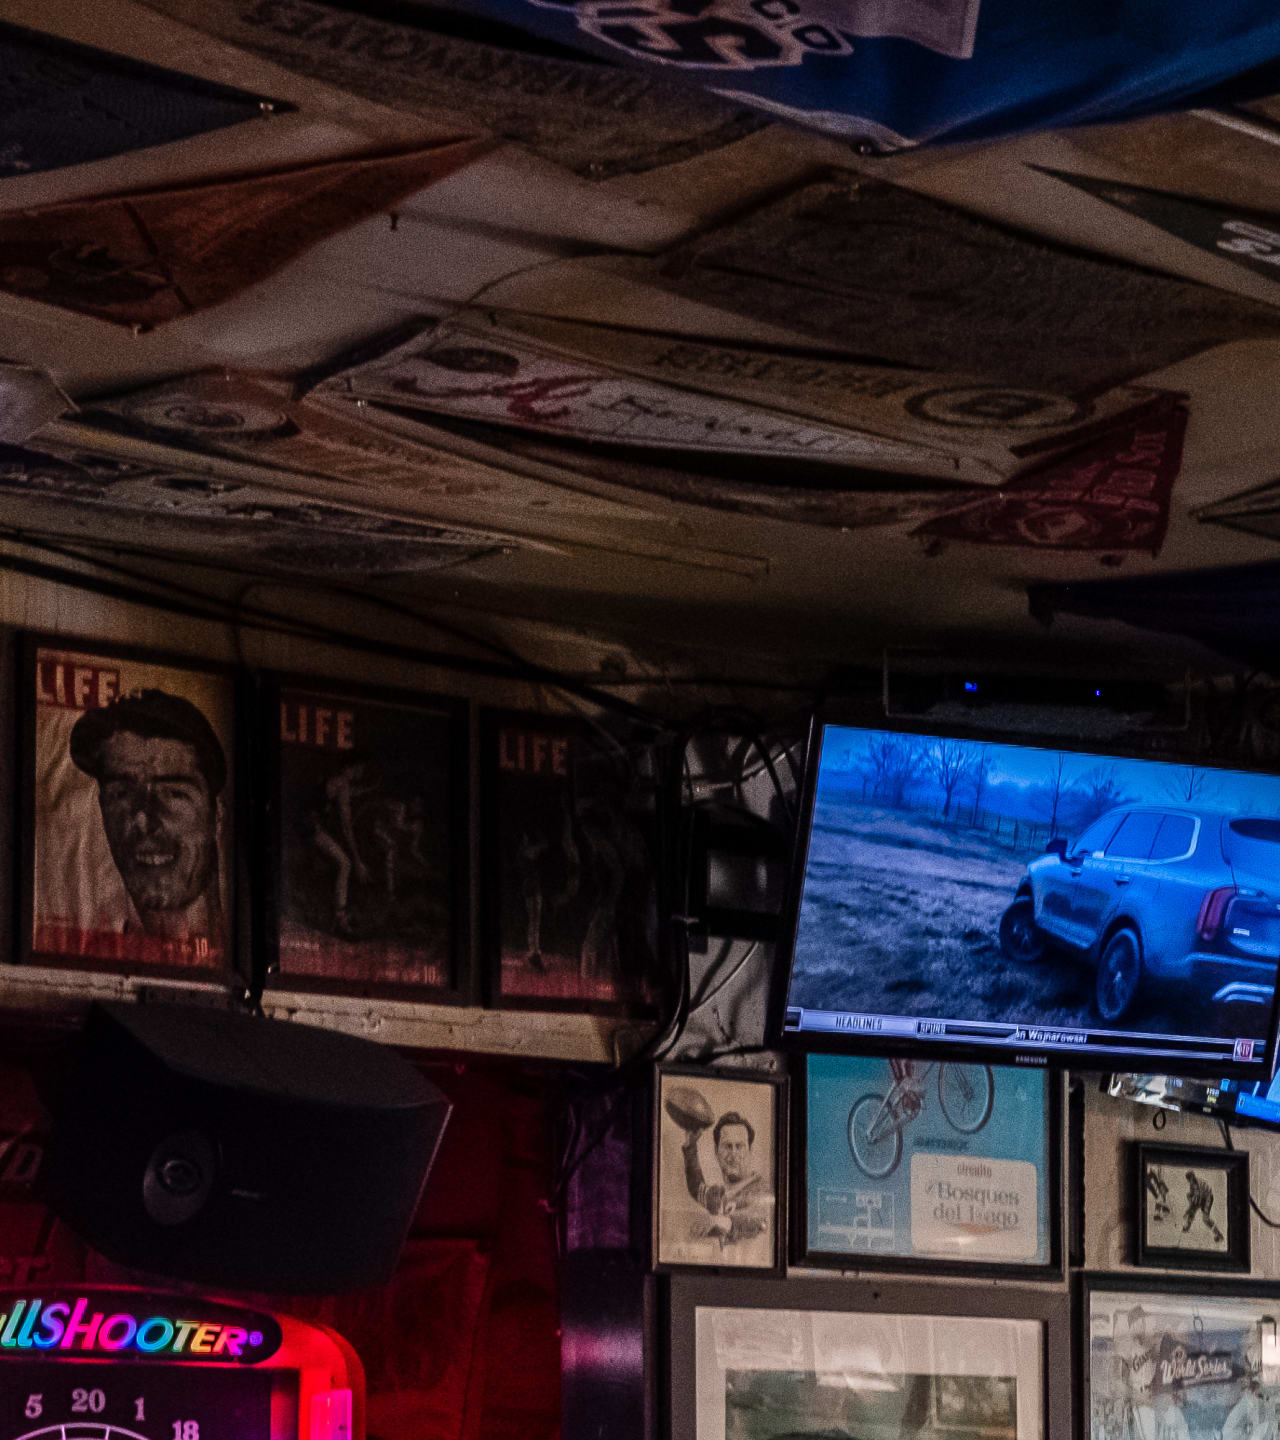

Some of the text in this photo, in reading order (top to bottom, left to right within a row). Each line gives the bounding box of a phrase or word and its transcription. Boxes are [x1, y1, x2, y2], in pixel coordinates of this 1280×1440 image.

[36, 659, 119, 706] LIFE
[280, 703, 356, 751] LIFE
[500, 732, 570, 776] LIFE
[835, 1015, 883, 1031] HEADLINES
[937, 1180, 1020, 1207] Bosques
[933, 1201, 961, 1222] del
[0, 1298, 246, 1356] llSHOOTER
[24, 1393, 44, 1419] 5
[71, 1387, 106, 1414] 20
[134, 1397, 146, 1421] 1
